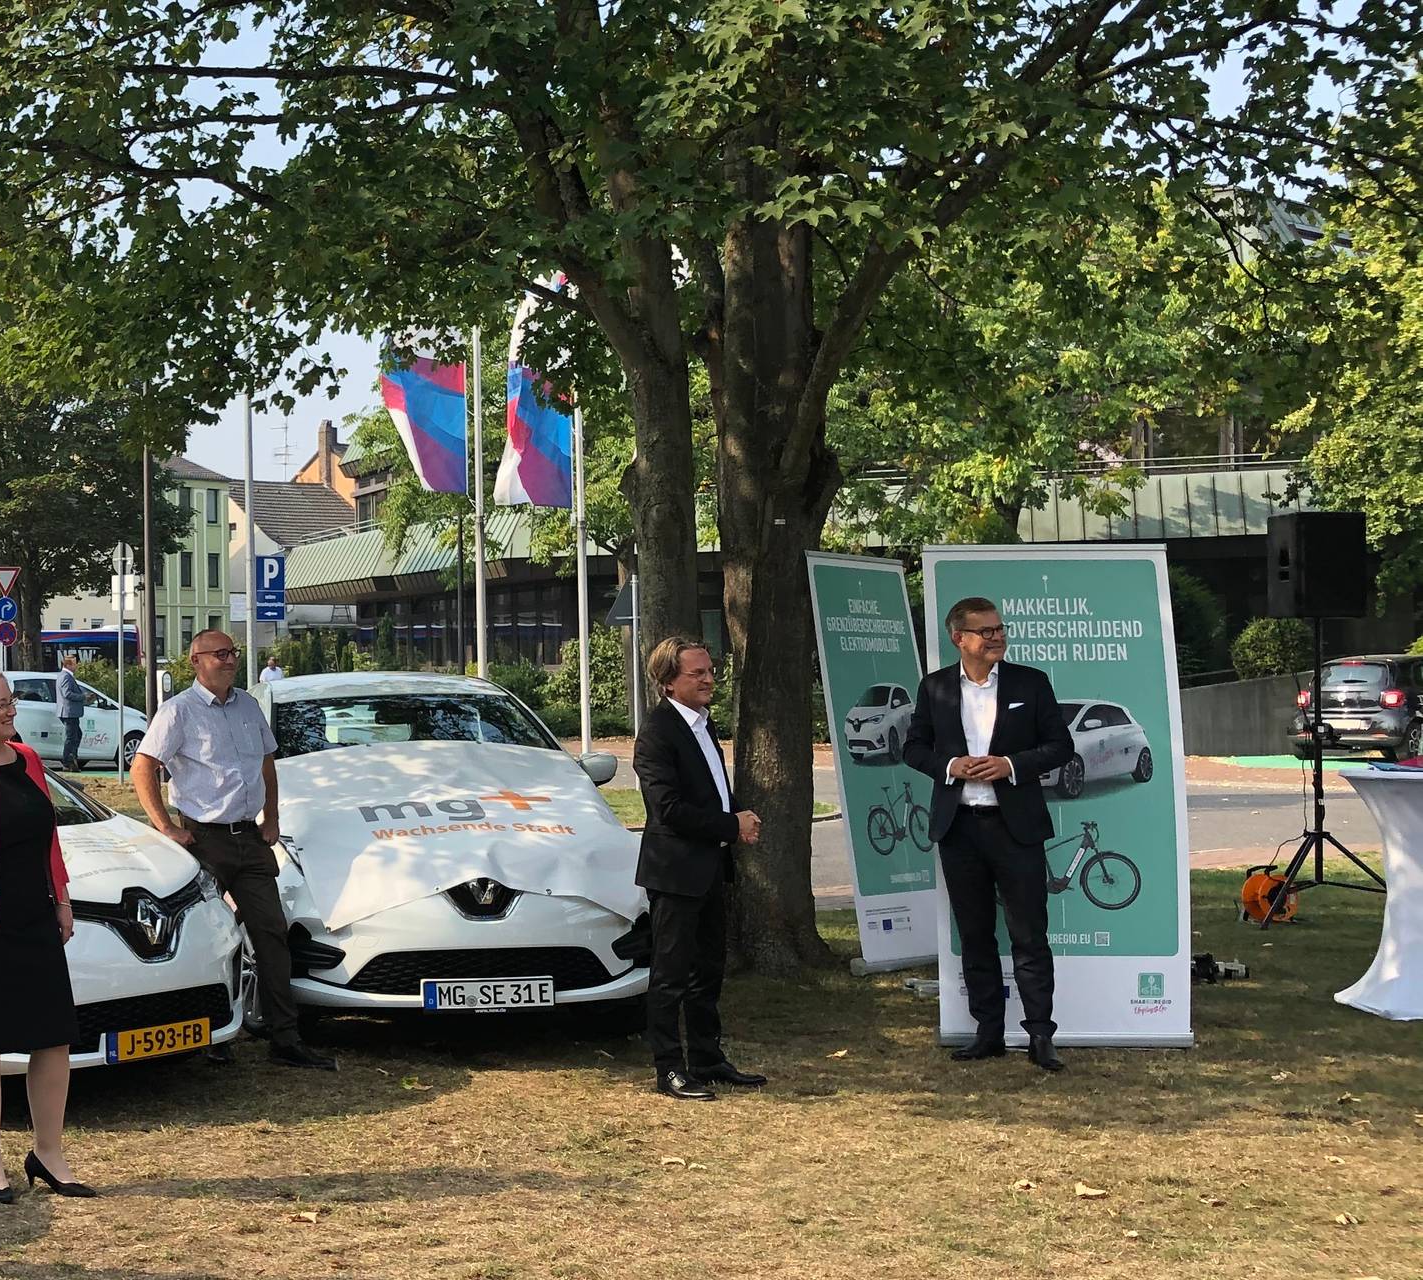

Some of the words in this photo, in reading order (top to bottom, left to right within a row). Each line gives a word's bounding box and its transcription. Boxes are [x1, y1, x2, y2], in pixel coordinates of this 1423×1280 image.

[263, 558, 279, 588] P
[1003, 620, 1143, 639] OVERSCHRIJDEND
[1003, 643, 1067, 662] KTRISCH
[1073, 643, 1128, 661] RIJDEN
[371, 821, 507, 841] Wachsende
[511, 822, 577, 836] Stadt
[1048, 933, 1091, 945] UREGIO.EU
[437, 985, 466, 1006] MG
[479, 984, 507, 1005] SE
[126, 1023, 203, 1056] J-593-FB
